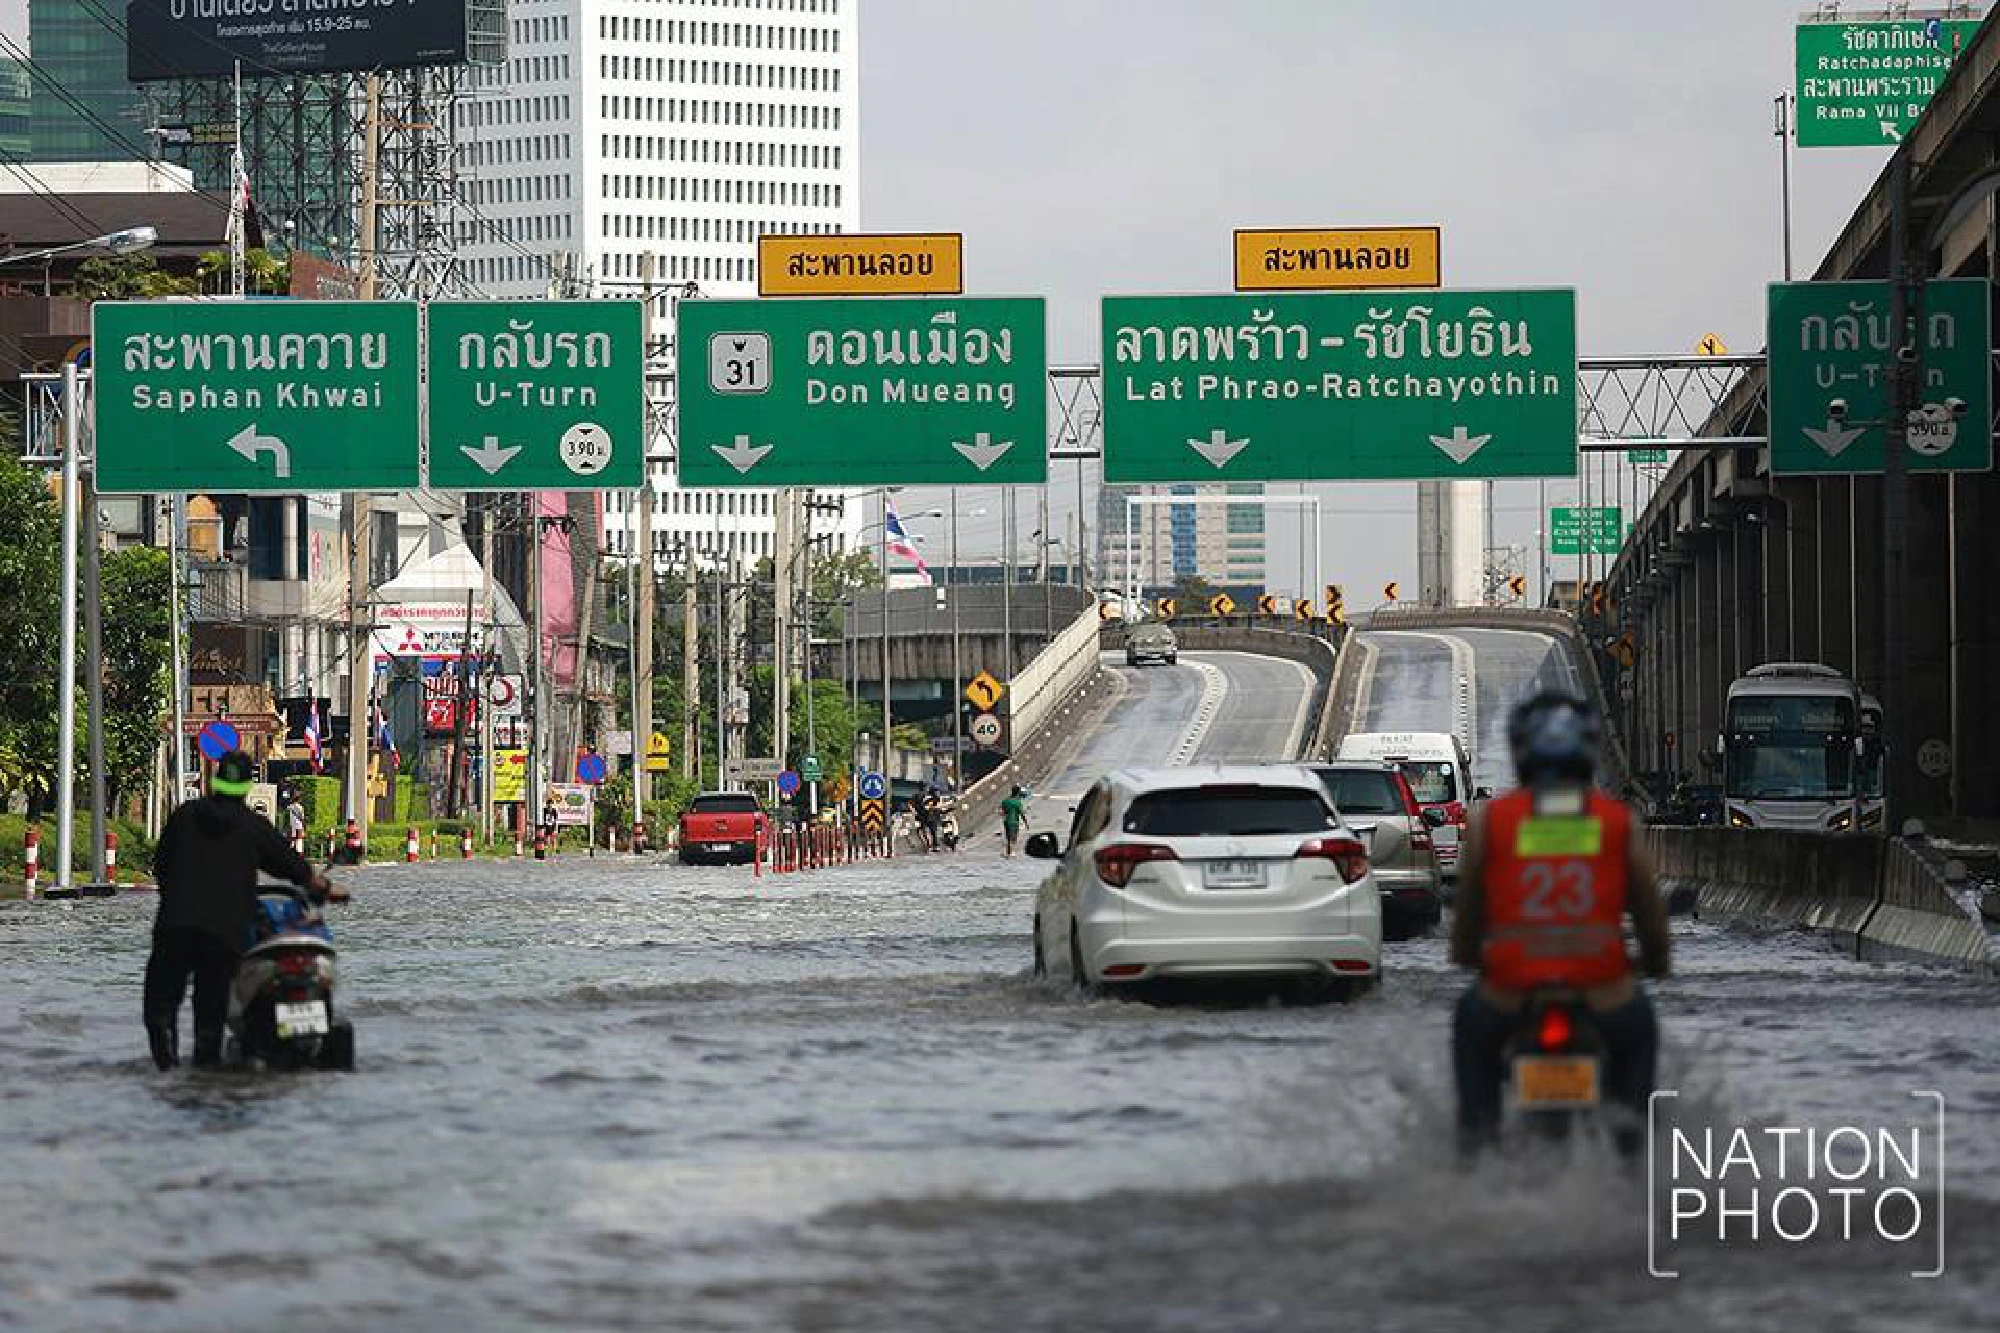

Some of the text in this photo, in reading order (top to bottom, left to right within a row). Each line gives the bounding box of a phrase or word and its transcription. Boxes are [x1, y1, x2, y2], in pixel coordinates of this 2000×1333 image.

[1816, 105, 1866, 119] Rama
[1874, 103, 1899, 118] VII
[788, 251, 934, 277] สะพานลอย
[1264, 245, 1411, 272] สะพานลอย
[459, 318, 611, 369] กลับรถ
[806, 310, 1012, 365] ดอนเมือง
[124, 332, 386, 372] สะพานควาย
[726, 359, 755, 386] 31
[1126, 370, 1559, 402] Lat Phrao-Ratchayothin
[1816, 364, 1944, 388] U-Tn
[132, 382, 382, 413] Saphan Khwai
[476, 382, 597, 406] U-Turn
[807, 379, 1015, 409] Don Mueang
[976, 722, 997, 735] 40
[1520, 860, 1596, 922] 23
